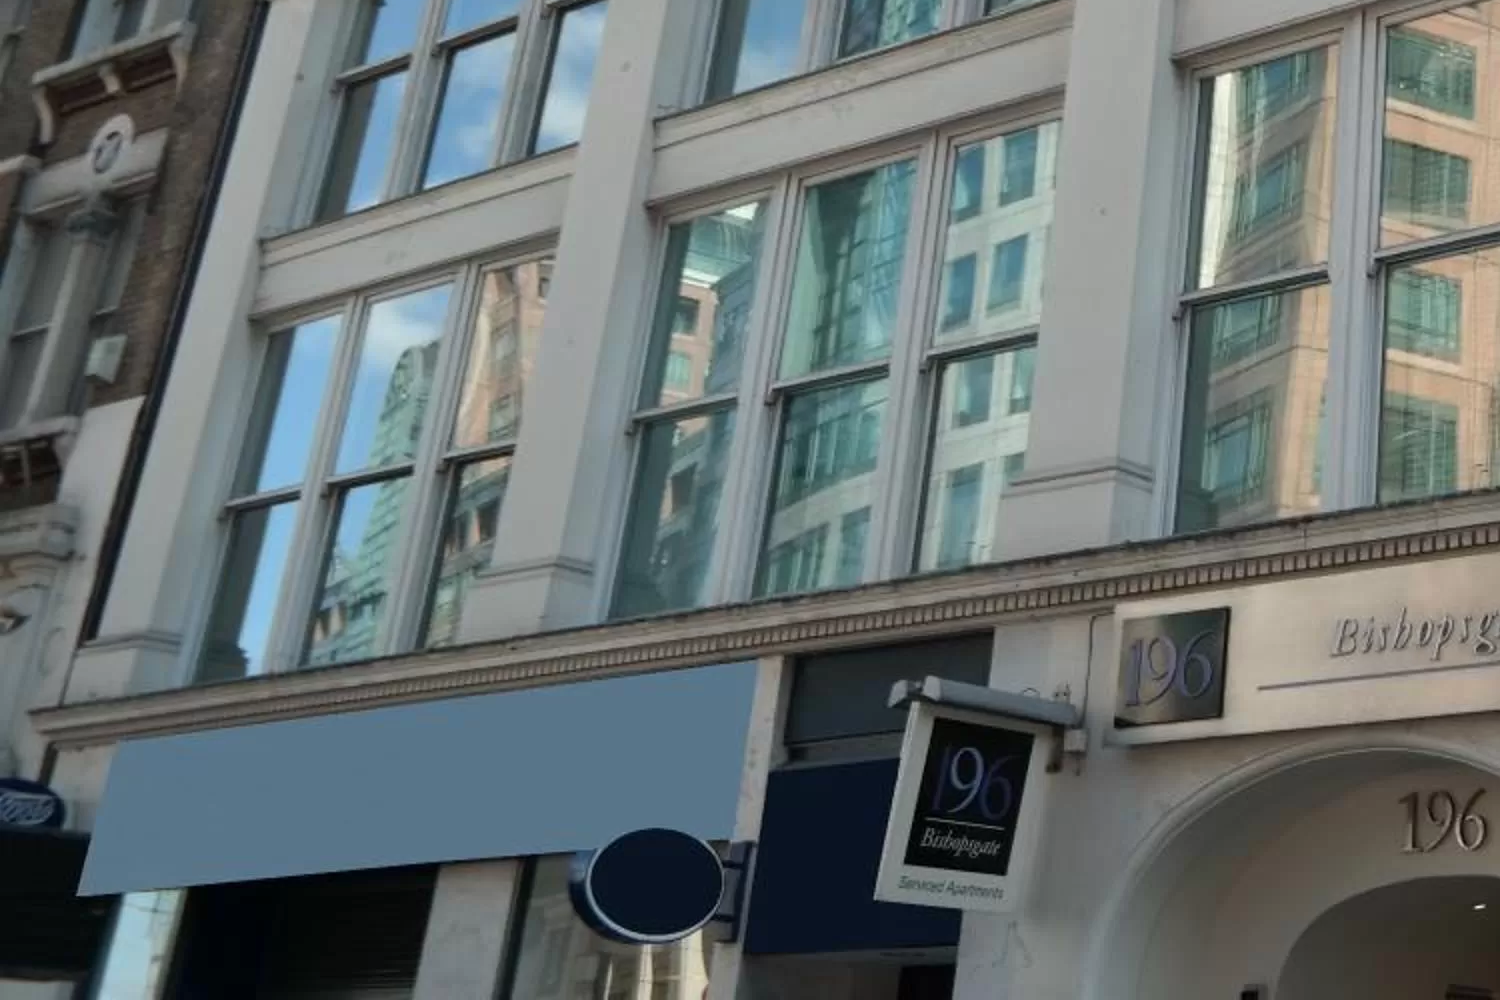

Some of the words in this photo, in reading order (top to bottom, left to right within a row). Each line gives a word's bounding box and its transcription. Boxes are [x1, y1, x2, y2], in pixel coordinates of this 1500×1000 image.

[1124, 631, 1215, 706] 196
[931, 747, 1021, 821] 196
[920, 827, 1001, 858] Bishopsgate
[1397, 787, 1487, 853] 196
